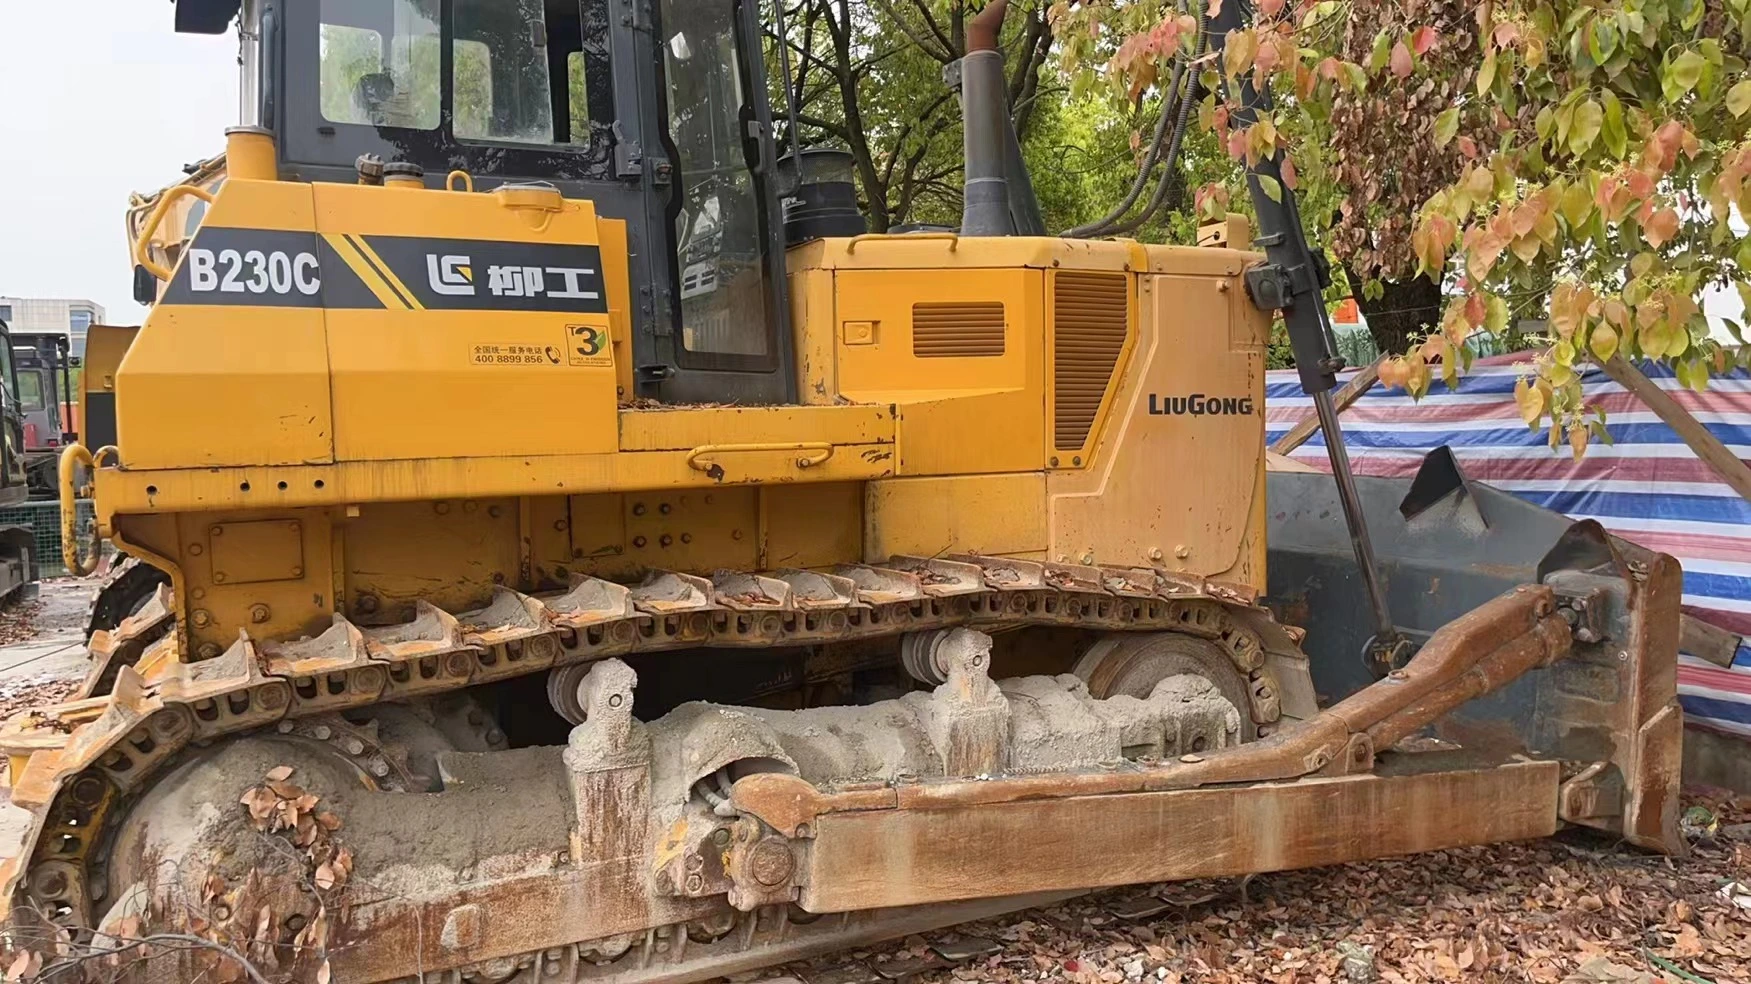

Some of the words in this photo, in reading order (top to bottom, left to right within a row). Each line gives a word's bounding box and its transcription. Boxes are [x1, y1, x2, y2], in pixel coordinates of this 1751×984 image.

[189, 248, 321, 295] B230C
[487, 265, 599, 299] 柳工
[474, 345, 542, 354] 全国统一服务电话
[475, 354, 494, 363] 400
[496, 354, 522, 363] 8899
[524, 355, 543, 363] 856
